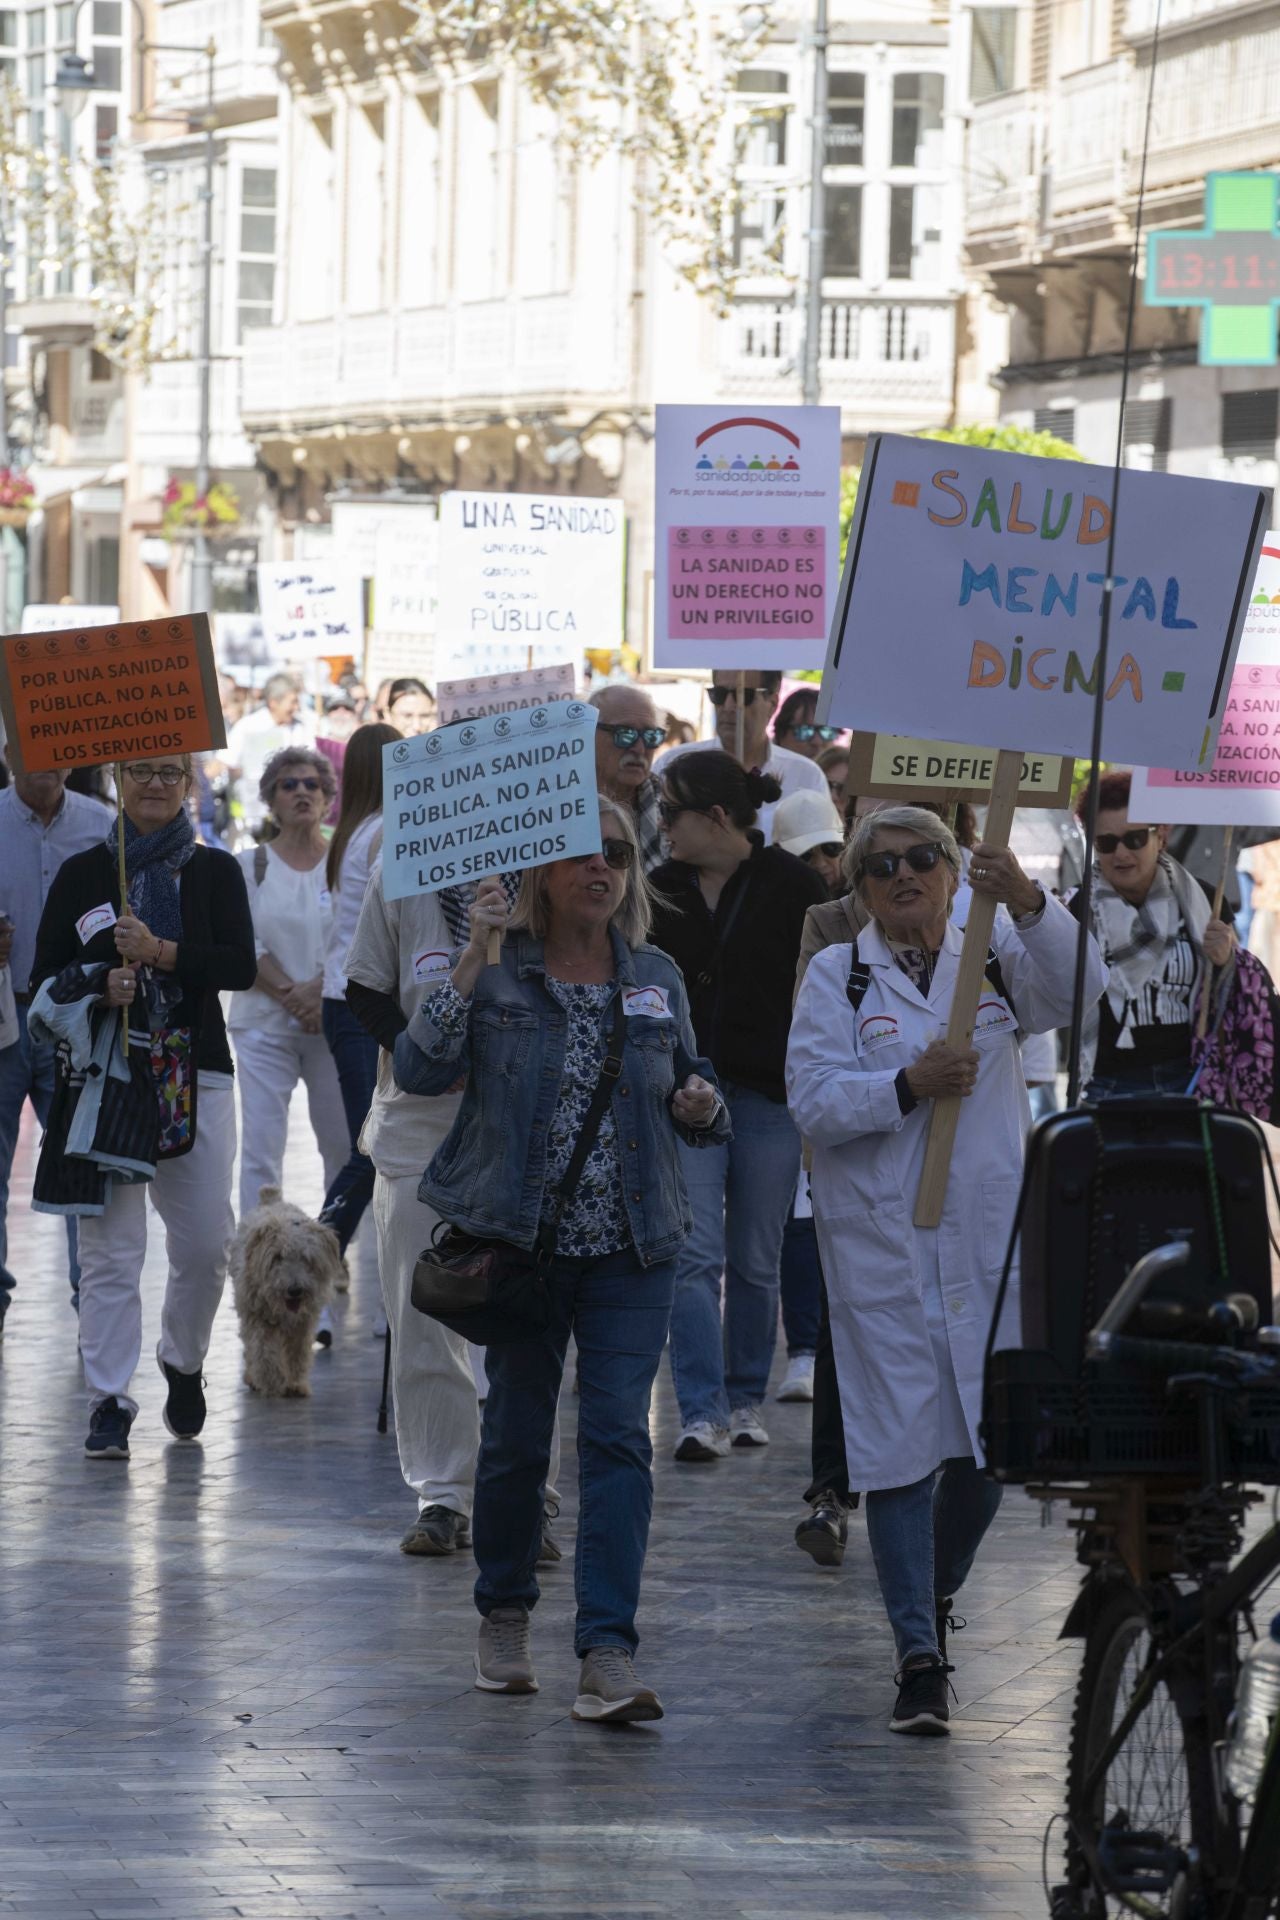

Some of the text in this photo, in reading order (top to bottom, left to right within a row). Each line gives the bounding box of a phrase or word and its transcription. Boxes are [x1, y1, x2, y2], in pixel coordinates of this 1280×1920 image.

[695, 470, 800, 483] sanidadpública
[462, 500, 616, 534] UNA SANIDAD
[927, 469, 1112, 545] SALUD
[681, 558, 815, 573] LA SANIDAD ES
[672, 584, 823, 599] UN DERECHO NO
[958, 558, 1198, 629] MENTAL
[471, 604, 577, 631] PÚBLICA
[681, 609, 814, 624] UN PRIVILEGIO
[20, 671, 58, 689] POR
[63, 666, 104, 684] UNA
[108, 655, 189, 679] SANIDAD
[30, 681, 189, 714] PÚBLICA. NO A LA
[440, 709, 461, 724] LA
[467, 696, 542, 718] SANIDAD
[30, 705, 197, 739] PRIVATIZACIÓN DE
[1244, 723, 1269, 736] NO
[53, 732, 183, 761] LOS SERVICIOS
[1217, 743, 1280, 760] IZACIÓN
[393, 777, 436, 800] POR
[442, 762, 485, 788] UNA
[491, 738, 585, 775] SANIDAD
[891, 755, 1044, 782] SE DEFIEDE
[1175, 769, 1280, 784] LOS SERVICIO
[399, 769, 580, 829] PÚBLICA. NO A LA
[395, 798, 586, 860] PRIVATIZACIÓN DE
[418, 834, 566, 886] LOS SERVICIOS
